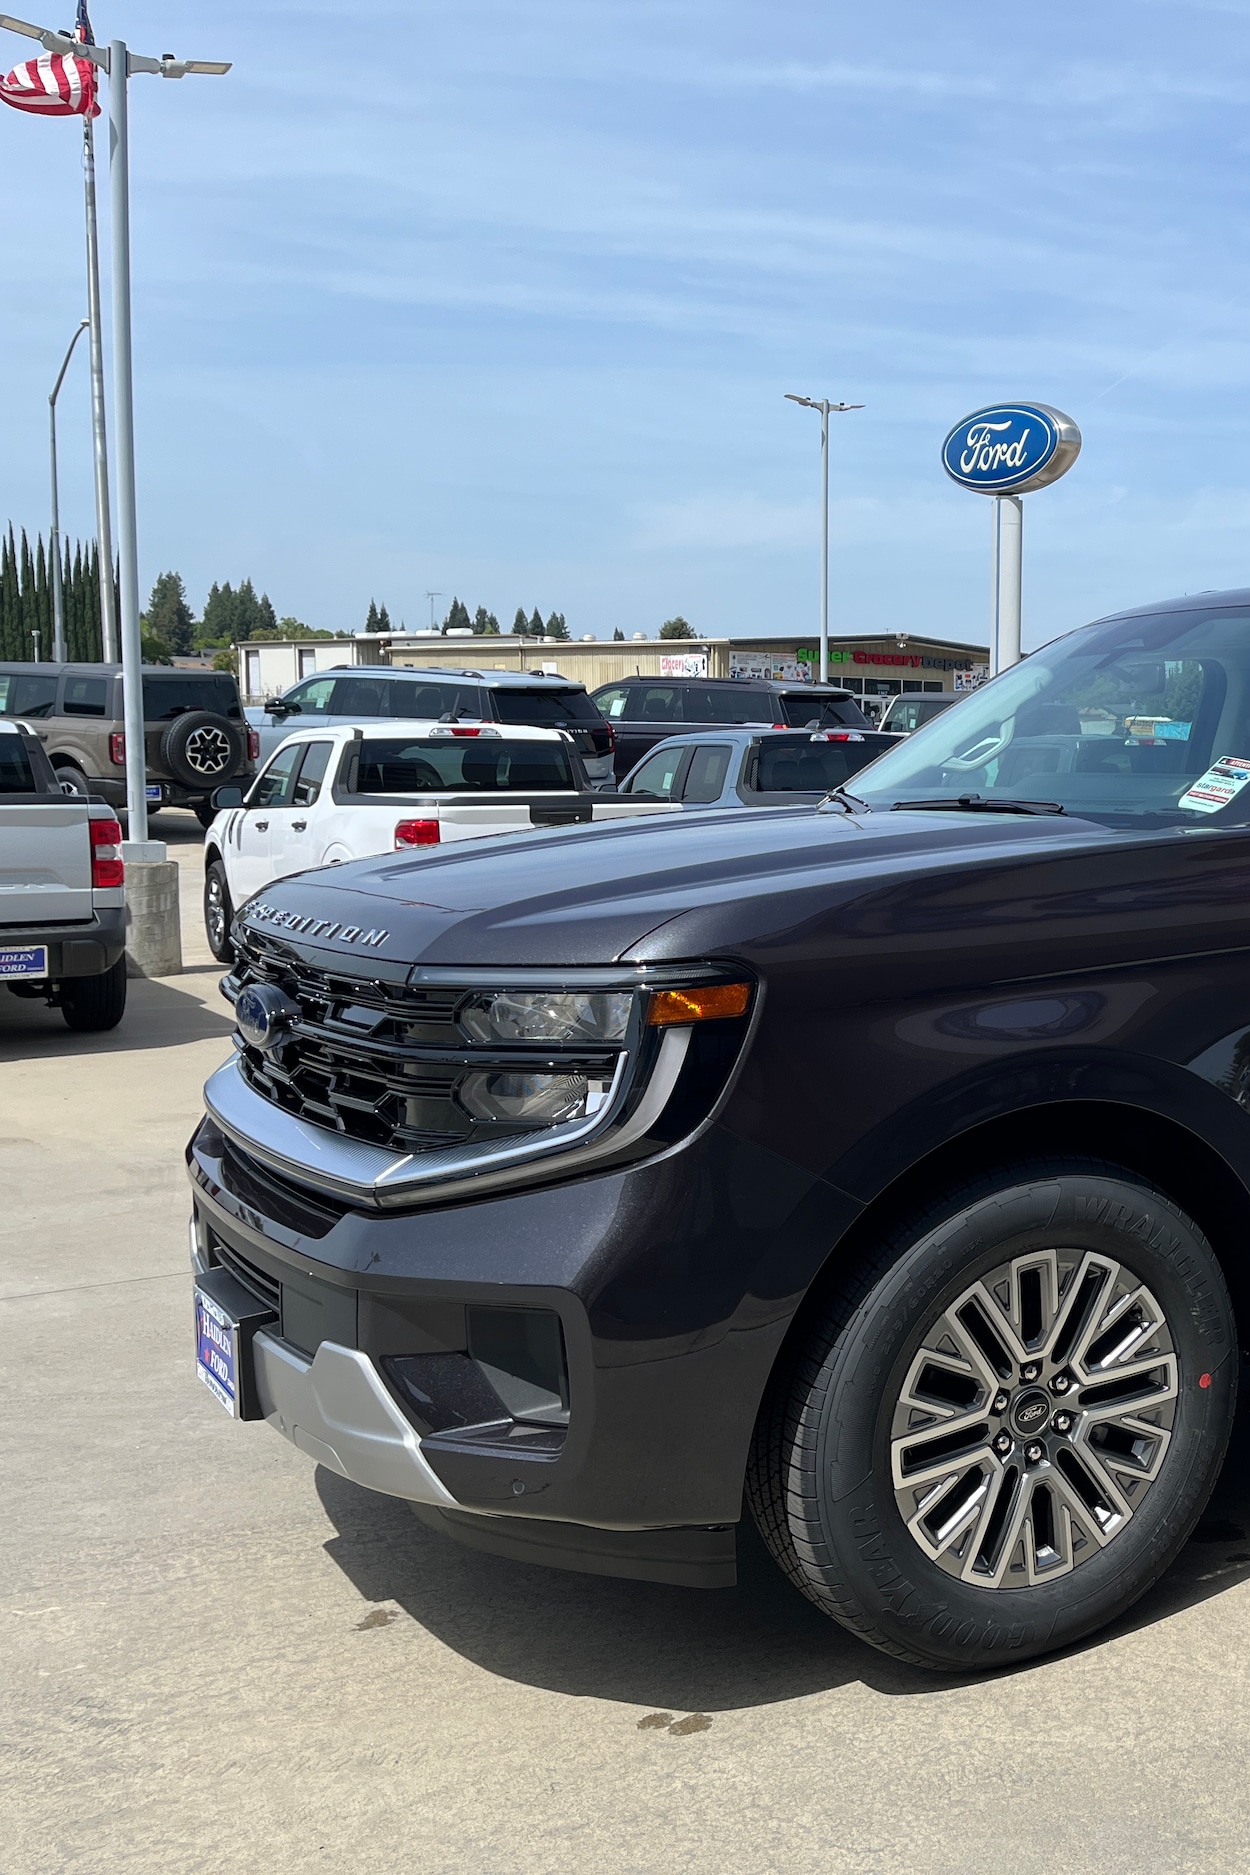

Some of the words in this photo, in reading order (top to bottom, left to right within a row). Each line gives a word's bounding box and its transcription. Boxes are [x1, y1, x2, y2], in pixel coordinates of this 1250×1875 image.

[960, 420, 1031, 474] Ford
[853, 651, 922, 668] Grocery
[922, 656, 974, 671] Depot
[246, 900, 391, 947] EXPEDITION
[0, 953, 35, 962] IDLEN
[210, 1350, 229, 1382] FORD
